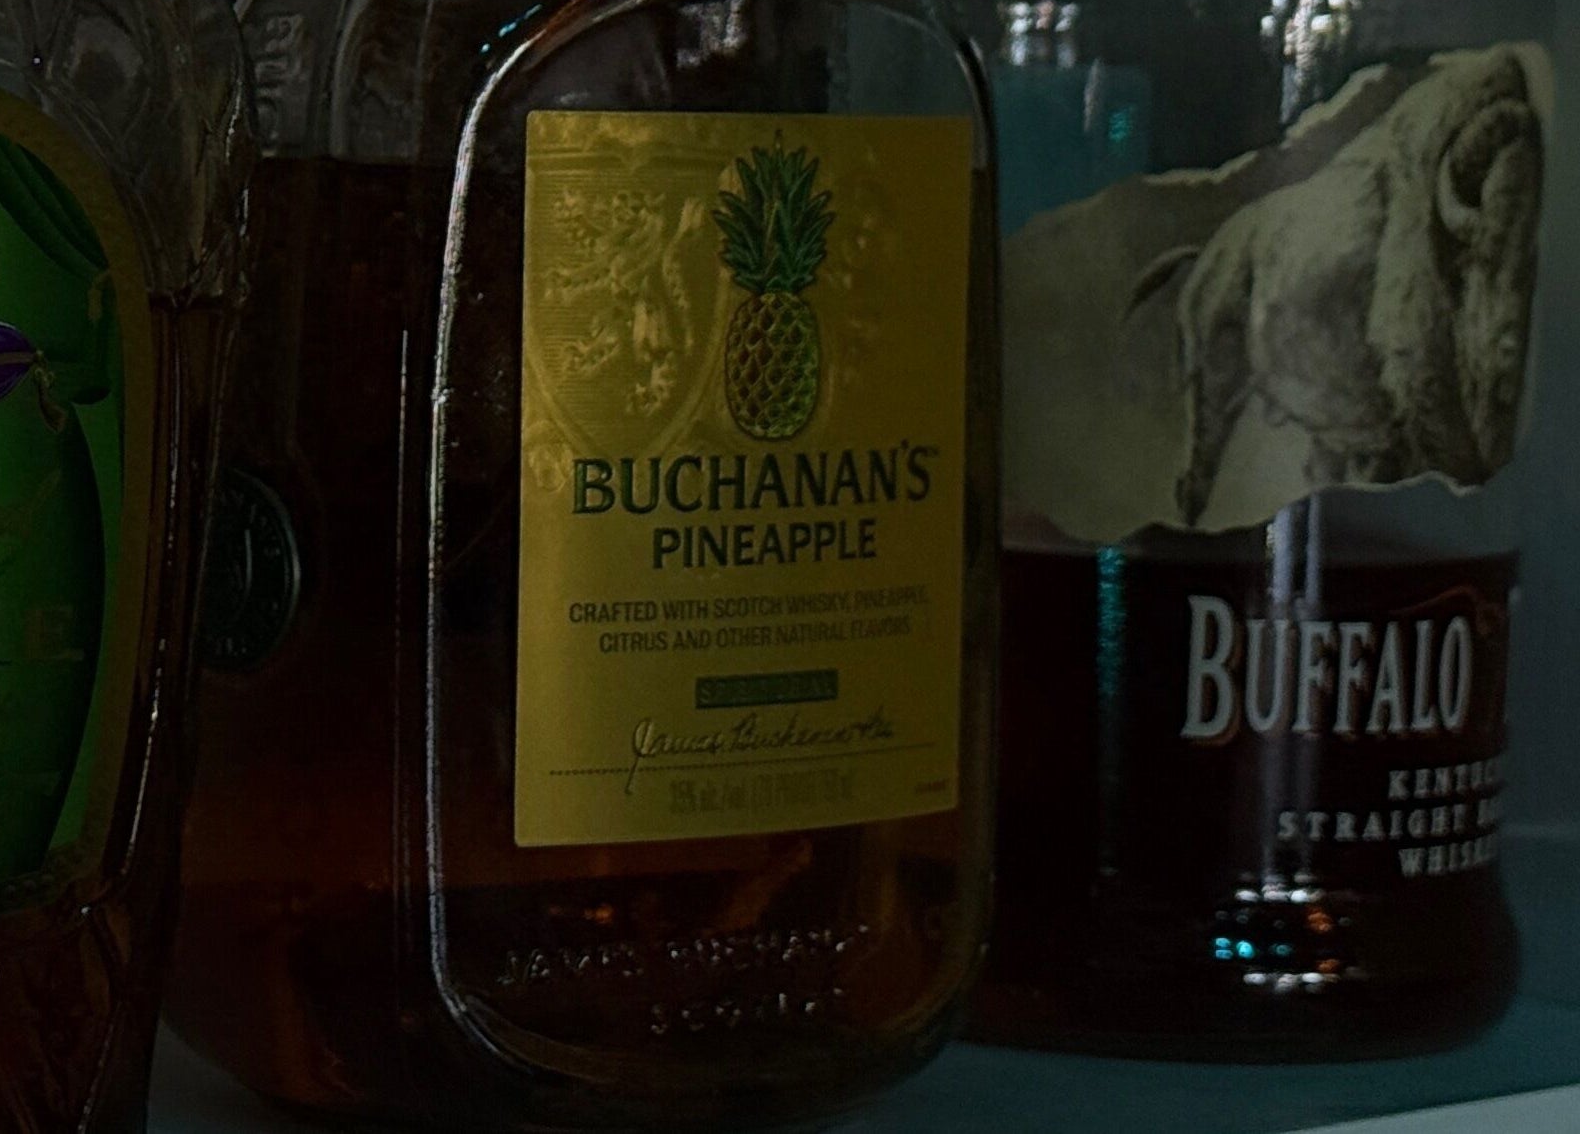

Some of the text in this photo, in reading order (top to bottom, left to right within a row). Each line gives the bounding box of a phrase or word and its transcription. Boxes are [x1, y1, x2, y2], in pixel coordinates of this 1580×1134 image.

[572, 439, 931, 515] BUCHANAN'S
[653, 518, 877, 569] PINEAPPLE
[569, 601, 658, 624] CRAFTED
[663, 599, 709, 621] WITH
[714, 595, 781, 619] SCOTCH
[599, 630, 669, 653] CITRUS
[673, 629, 712, 651] AND
[716, 626, 772, 649] OTHER
[1179, 593, 1474, 741] BUFFALO
[1276, 802, 1468, 843] STRAIGHT
